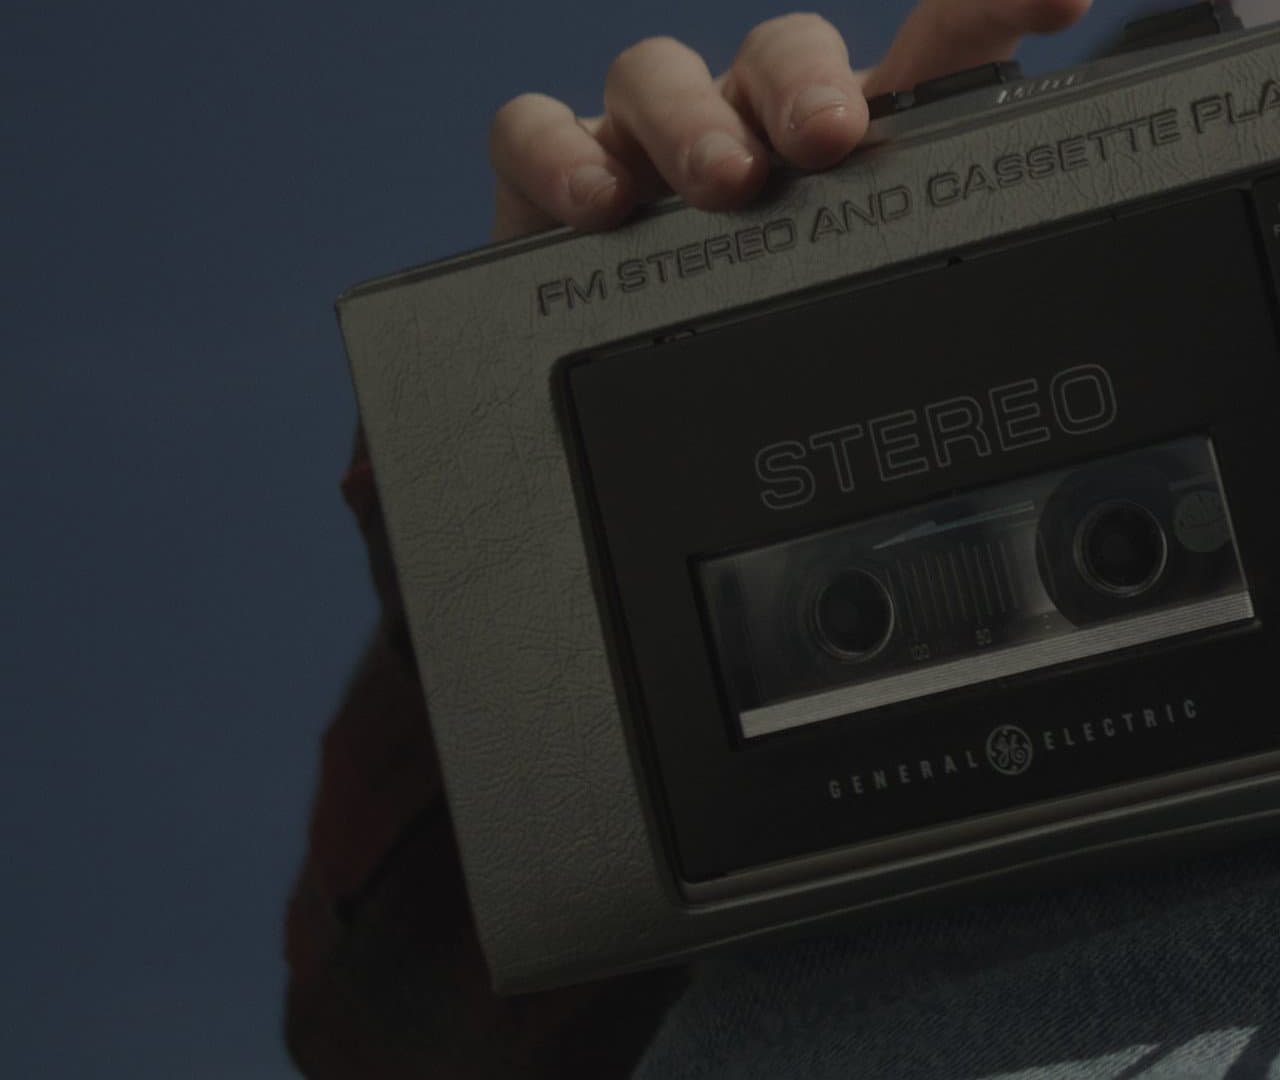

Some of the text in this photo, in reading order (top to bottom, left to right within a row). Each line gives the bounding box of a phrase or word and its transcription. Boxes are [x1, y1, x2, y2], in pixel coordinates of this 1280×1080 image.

[537, 270, 606, 317] FM
[617, 218, 796, 294] STEREO
[810, 184, 910, 244] AND
[927, 108, 1180, 208] CASSETTE
[755, 363, 1118, 510] STEREO
[828, 749, 978, 800] GENERAL
[1043, 698, 1200, 751] ELECTRIC
